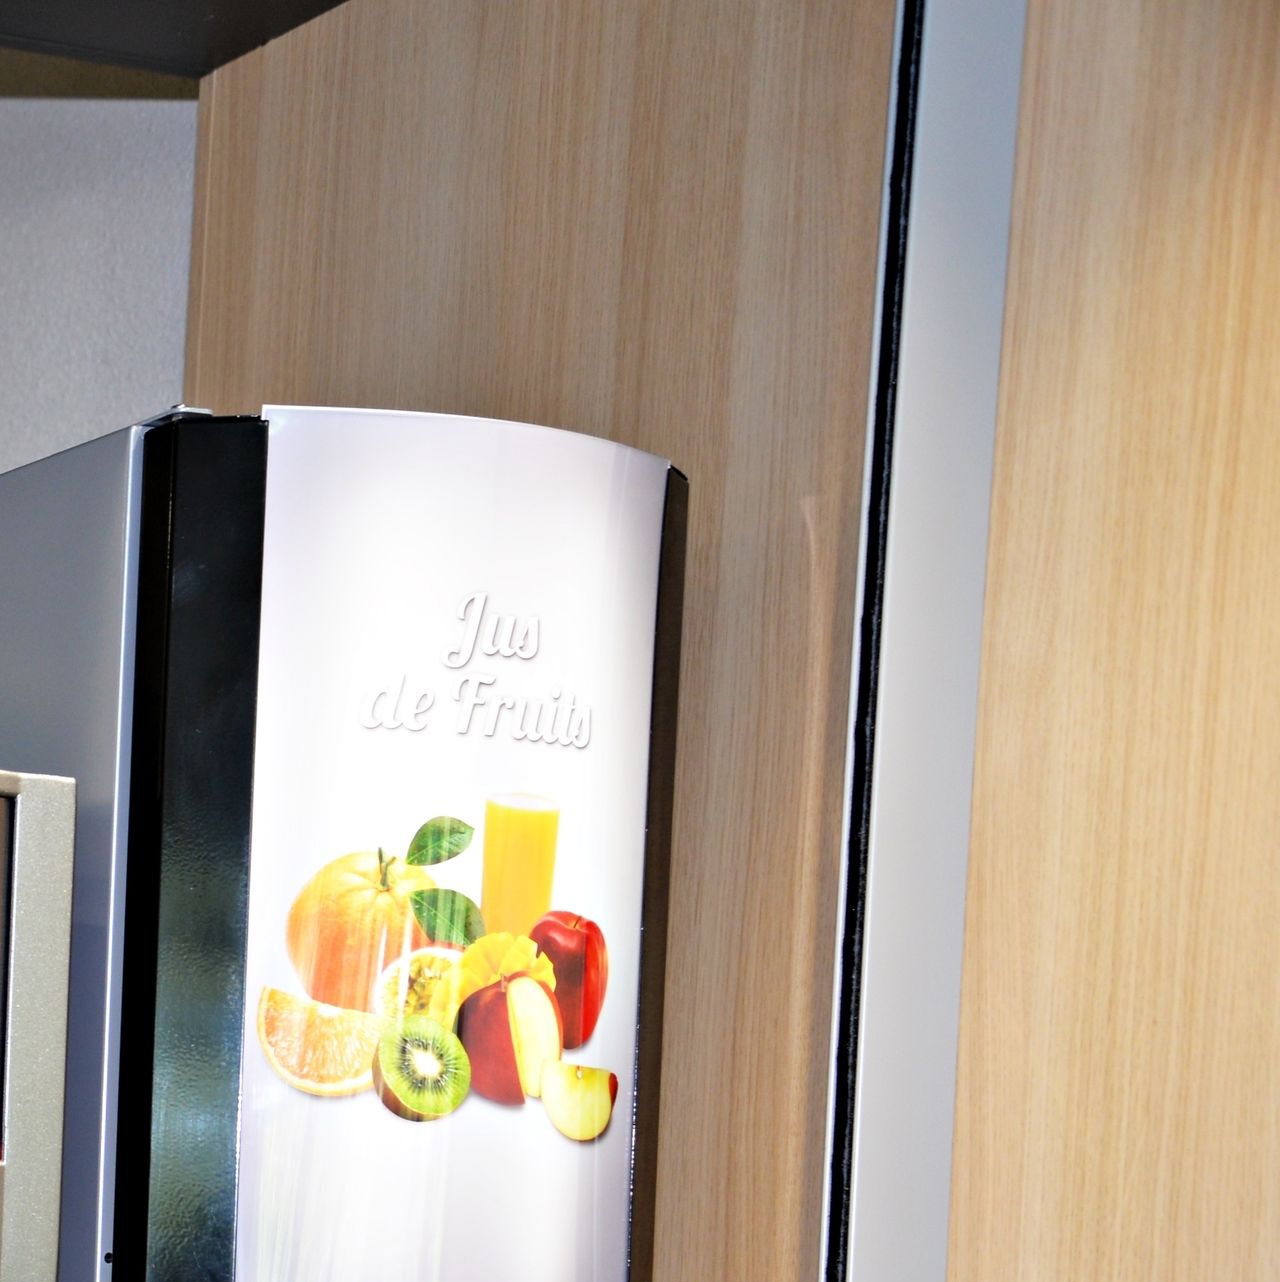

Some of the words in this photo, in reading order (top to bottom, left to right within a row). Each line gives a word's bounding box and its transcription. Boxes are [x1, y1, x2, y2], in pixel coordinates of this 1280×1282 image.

[443, 592, 540, 670] Jus
[359, 673, 436, 732] de
[454, 673, 592, 749] Fruits
